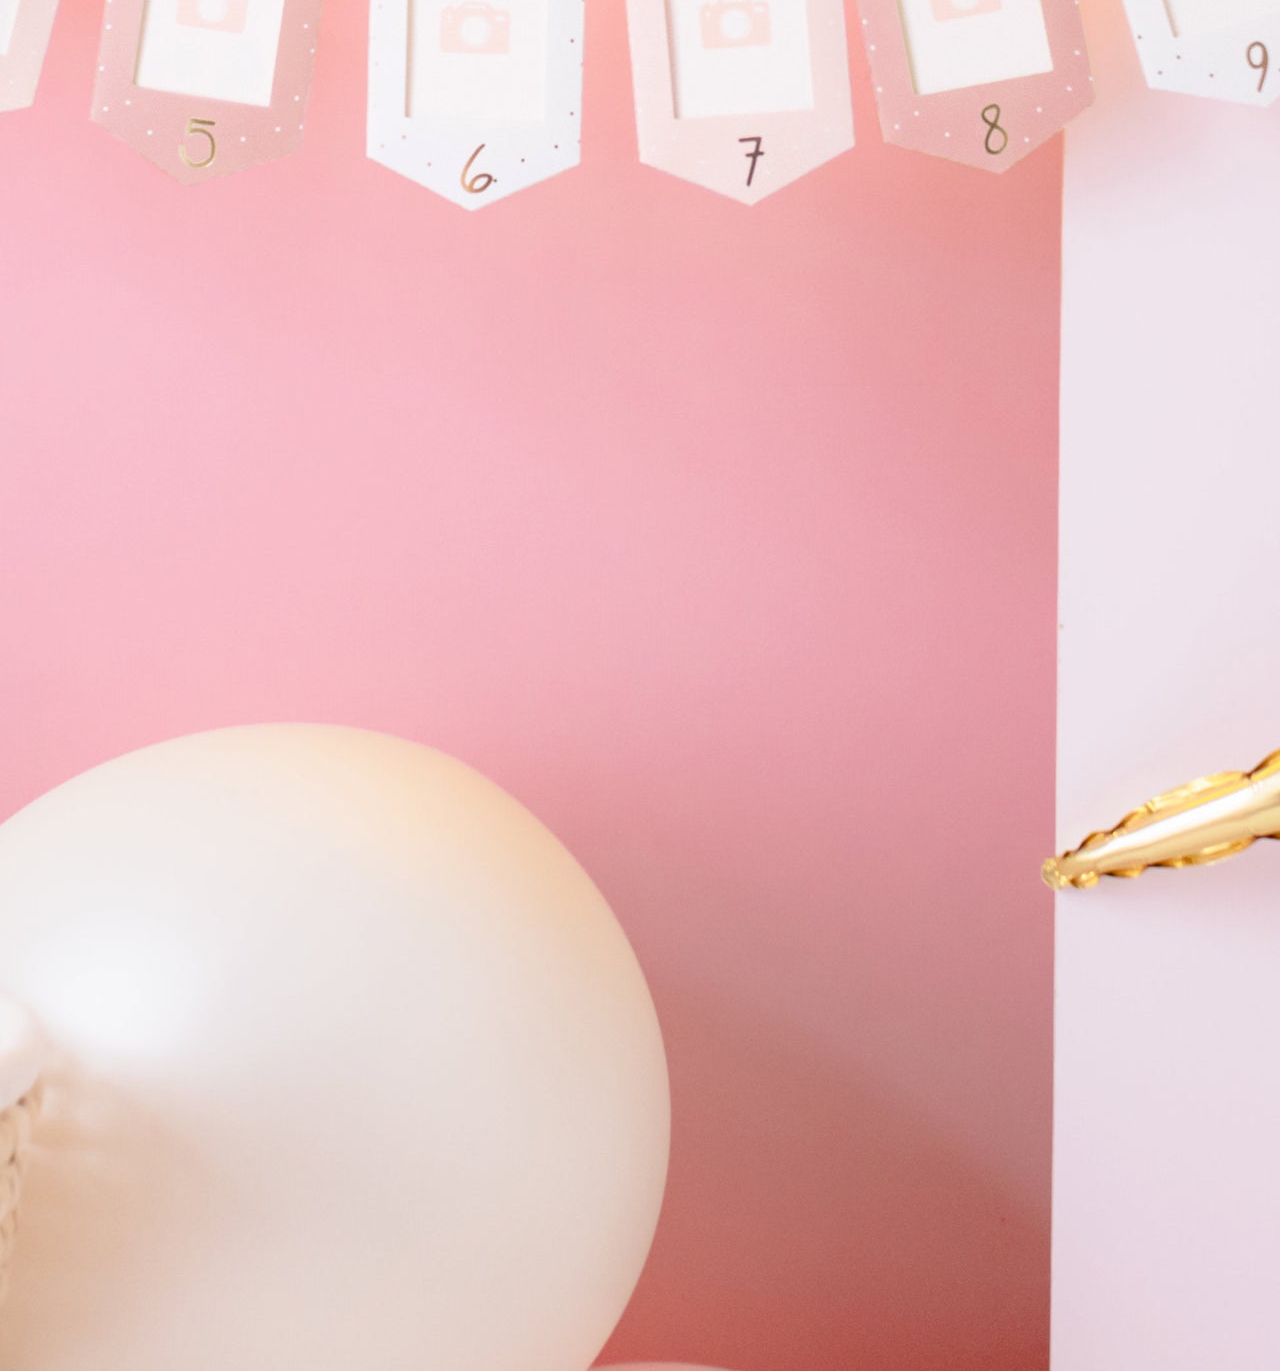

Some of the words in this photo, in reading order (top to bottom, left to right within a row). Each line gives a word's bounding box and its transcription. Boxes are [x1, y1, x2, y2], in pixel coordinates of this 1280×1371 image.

[1246, 41, 1269, 93] 9
[178, 118, 216, 168] 5
[981, 103, 1008, 155] 8
[460, 143, 493, 193] 6
[738, 136, 765, 187] 7
